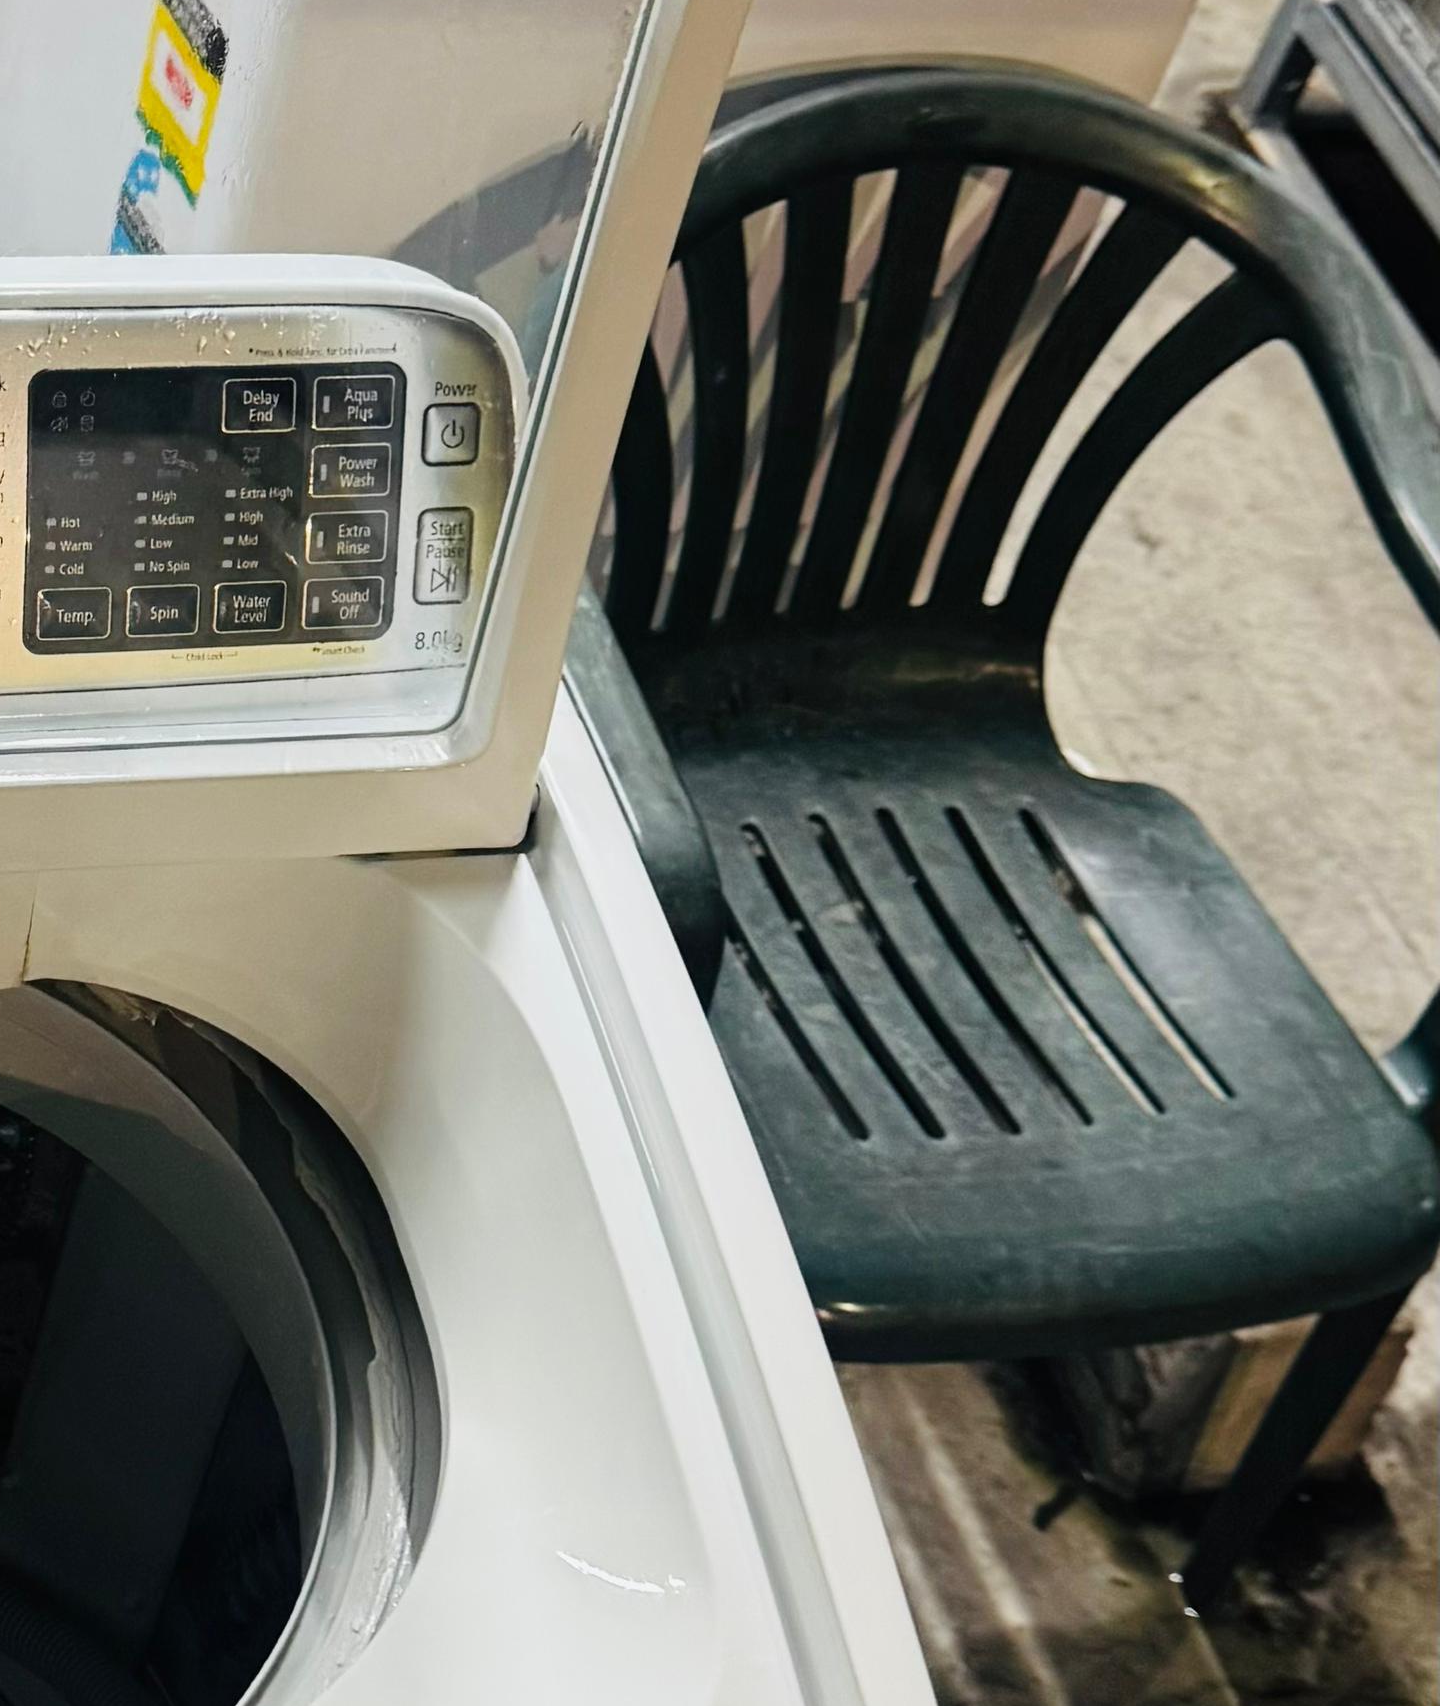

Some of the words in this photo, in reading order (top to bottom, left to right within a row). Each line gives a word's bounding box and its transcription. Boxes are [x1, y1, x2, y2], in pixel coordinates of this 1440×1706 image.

[242, 389, 280, 407] Delay
[344, 387, 378, 404] Aqua
[248, 407, 274, 423] End
[338, 455, 378, 471] Power
[339, 471, 376, 488] Wash
[151, 490, 177, 505] High
[239, 487, 266, 500] Extra
[268, 486, 294, 501] High
[60, 516, 81, 529] Hot
[151, 513, 195, 527] Medium
[239, 511, 264, 525] High
[338, 523, 371, 538] Extra
[430, 520, 465, 536] Start
[59, 540, 93, 553] Warm
[150, 537, 173, 551] Low
[237, 533, 259, 547] Mid
[336, 541, 371, 556] Rinse
[425, 543, 465, 559] Pause
[59, 562, 85, 576] Cold
[148, 560, 164, 574] No
[166, 559, 191, 576] Spin
[236, 558, 260, 571] Low
[232, 593, 272, 609] Water
[331, 588, 370, 604] Sound
[55, 607, 97, 628] Temp.
[149, 605, 180, 623] Spin
[234, 609, 268, 624] Level
[339, 605, 360, 621] Off
